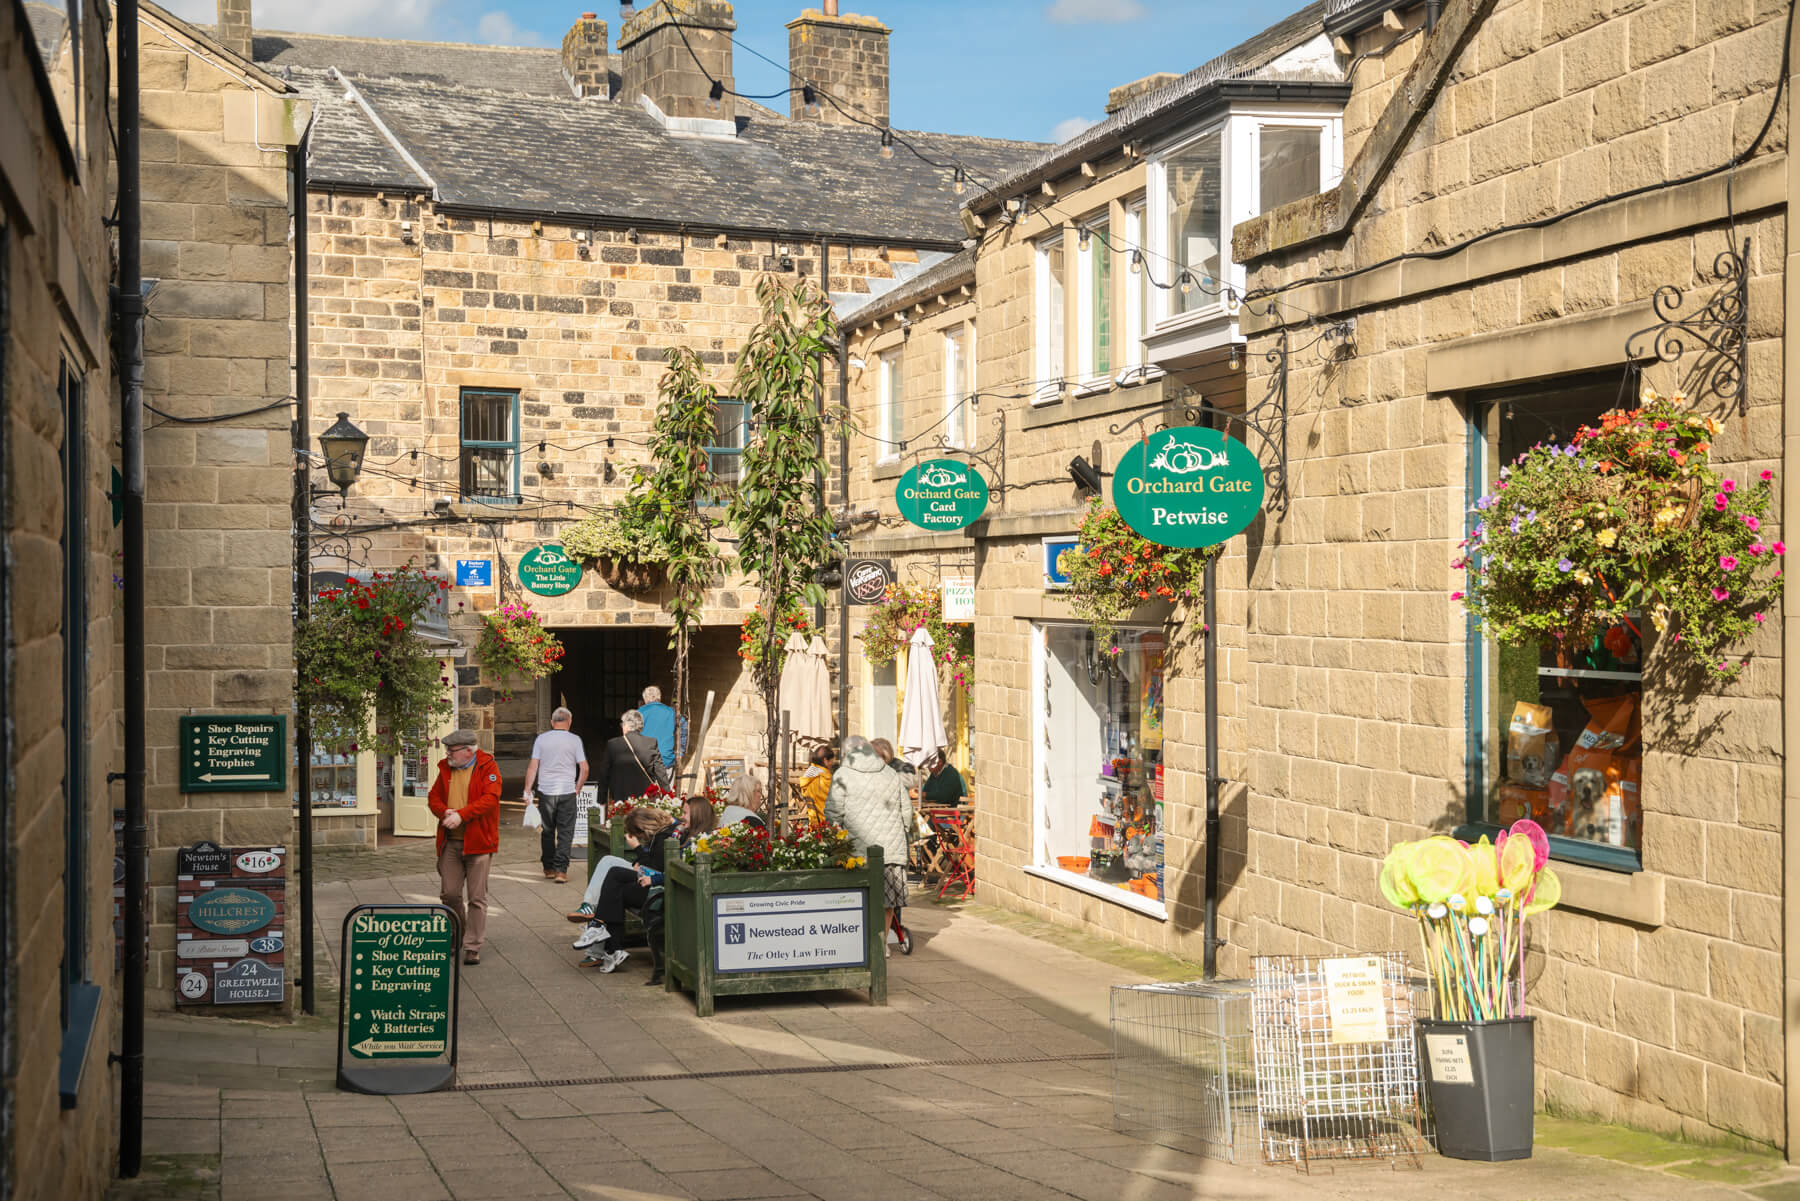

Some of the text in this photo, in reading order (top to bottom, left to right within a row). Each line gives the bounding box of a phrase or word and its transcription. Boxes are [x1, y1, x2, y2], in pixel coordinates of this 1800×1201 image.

[1127, 475, 1252, 494] Orchard Gate
[904, 488, 980, 499] Orchard Gate
[930, 501, 956, 512] Card
[923, 513, 963, 526] Factory
[1152, 506, 1228, 526] Petwise
[523, 565, 576, 573] Orchard Gate
[857, 576, 883, 599] 1882
[208, 724, 274, 734] Shoe Repairs
[208, 736, 269, 746] Key Cutting
[208, 747, 262, 758] Engraving
[208, 758, 255, 769] Trophies
[185, 853, 226, 862] Newton's
[251, 856, 266, 868] 16
[192, 863, 219, 871] House
[199, 906, 266, 917] HILLCREST
[750, 902, 774, 910] Growing
[355, 915, 447, 933] Shoecraft
[730, 924, 739, 933] N
[750, 923, 860, 938] Newstead & Walker
[378, 934, 425, 948] of Otley
[730, 934, 741, 943] W
[259, 939, 275, 951] 38
[372, 950, 446, 963] Shoe Repairs
[747, 948, 836, 960] The Otley Law Firm
[241, 963, 258, 976] 24
[372, 965, 440, 978] Key Cutting
[185, 980, 202, 992] 24
[218, 978, 279, 988] GREETWELL
[372, 980, 431, 993] Engraving
[370, 1009, 446, 1022] Watch Straps
[369, 1023, 434, 1034] & Batteries
